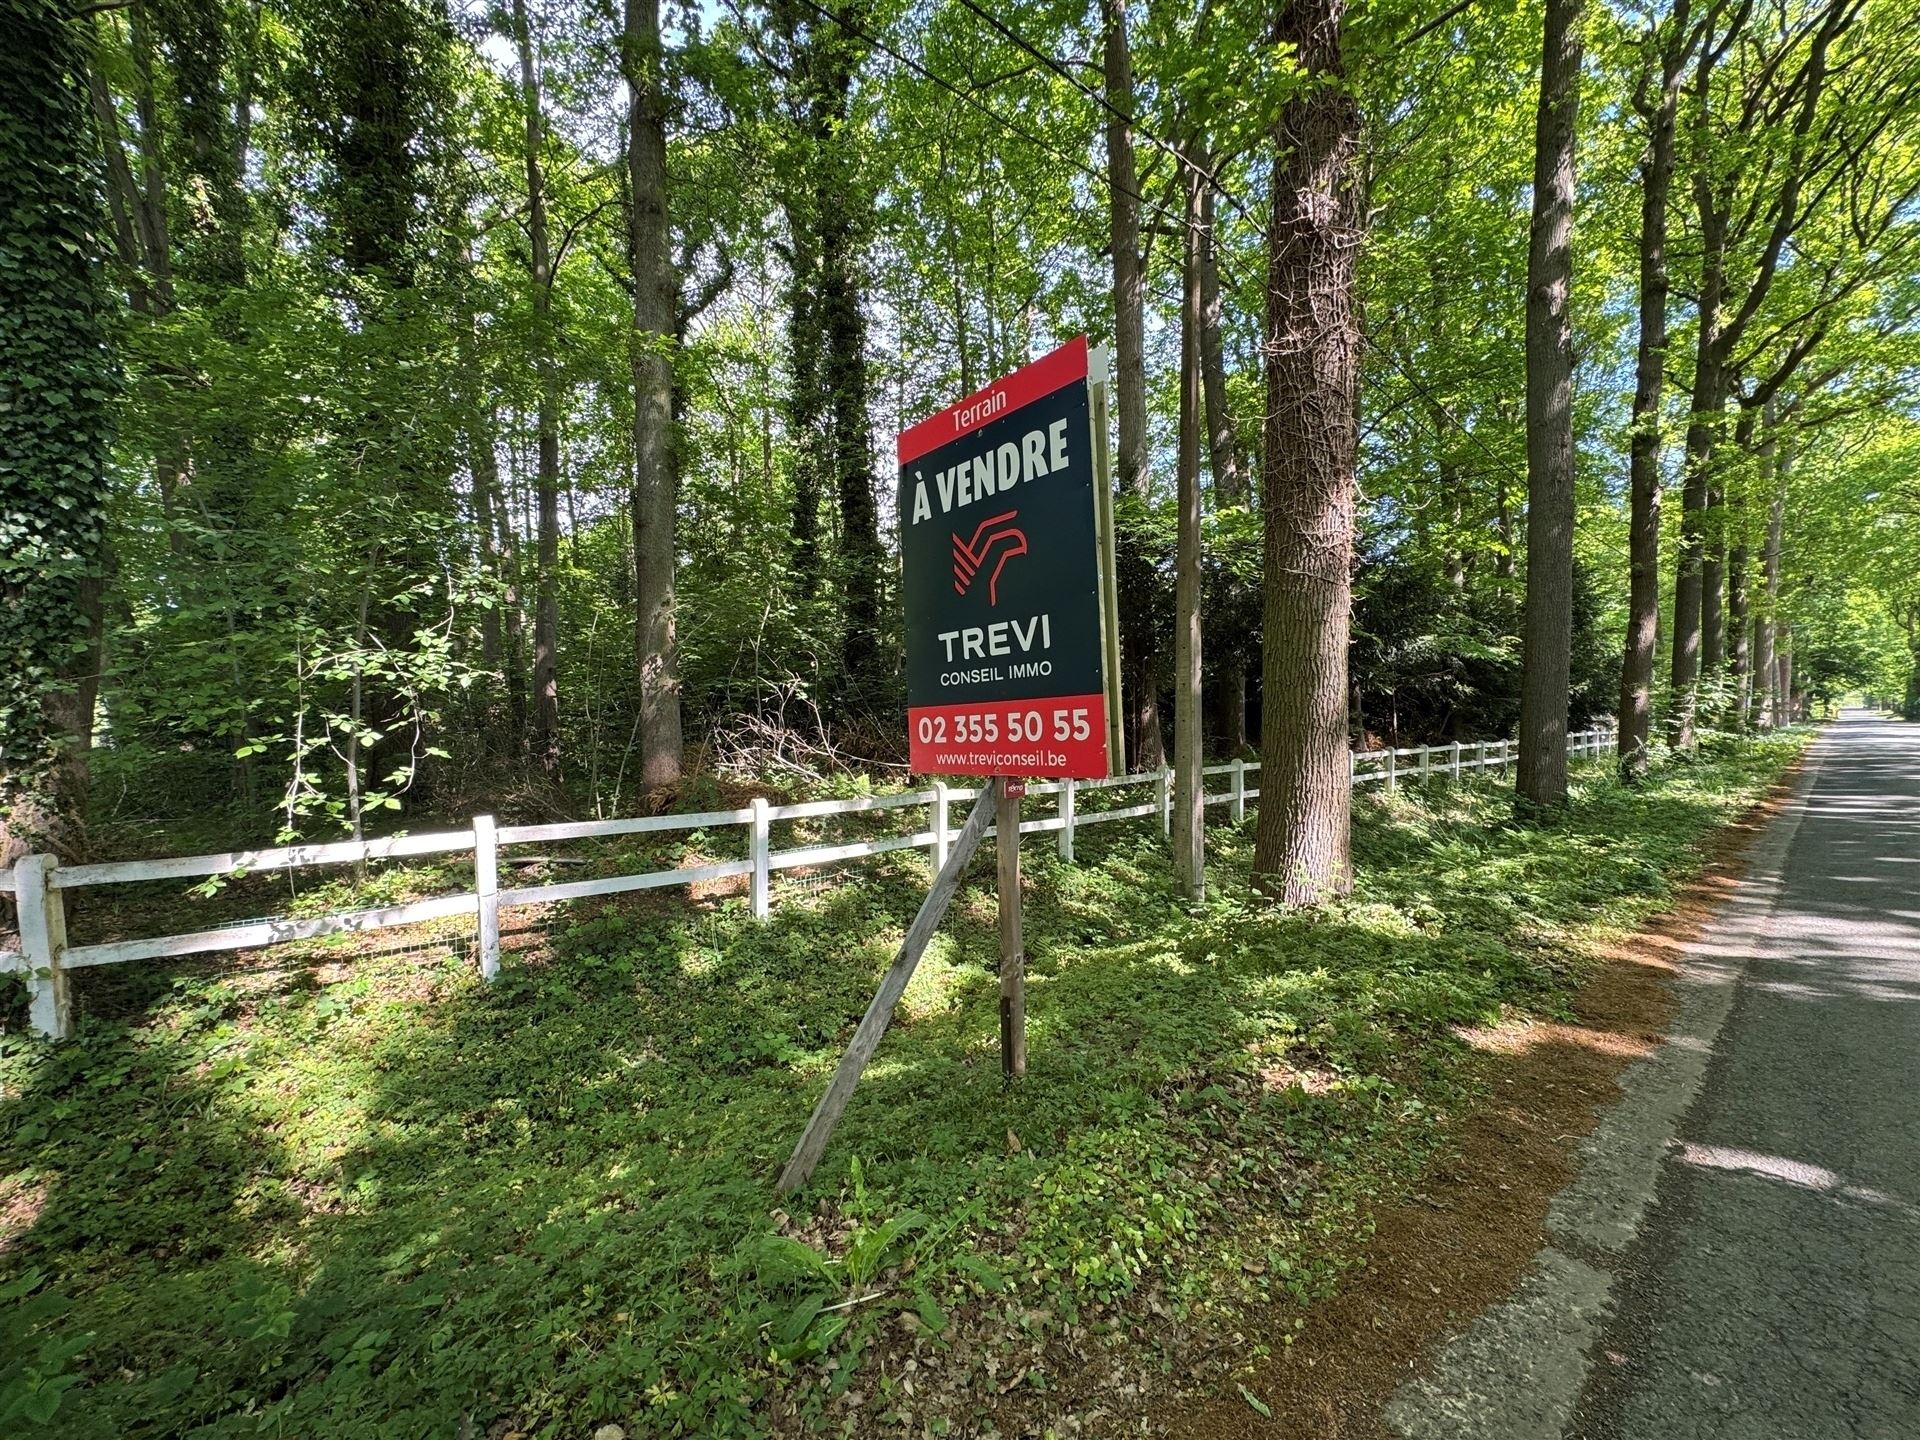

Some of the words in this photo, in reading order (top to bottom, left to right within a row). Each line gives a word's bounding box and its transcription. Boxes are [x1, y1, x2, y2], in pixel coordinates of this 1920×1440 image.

[953, 390, 1007, 432] Terrain
[912, 470, 932, 526] À
[935, 417, 1070, 514] VENDRE
[938, 614, 1051, 662] TREVI
[940, 667, 1004, 687] CONSEIL
[1009, 660, 1052, 679] IMMO
[918, 716, 947, 744] 02
[954, 713, 999, 743] 355
[1007, 711, 1043, 742] 50
[1053, 708, 1091, 742] 55
[936, 750, 1067, 767] www.treviconseil.be
